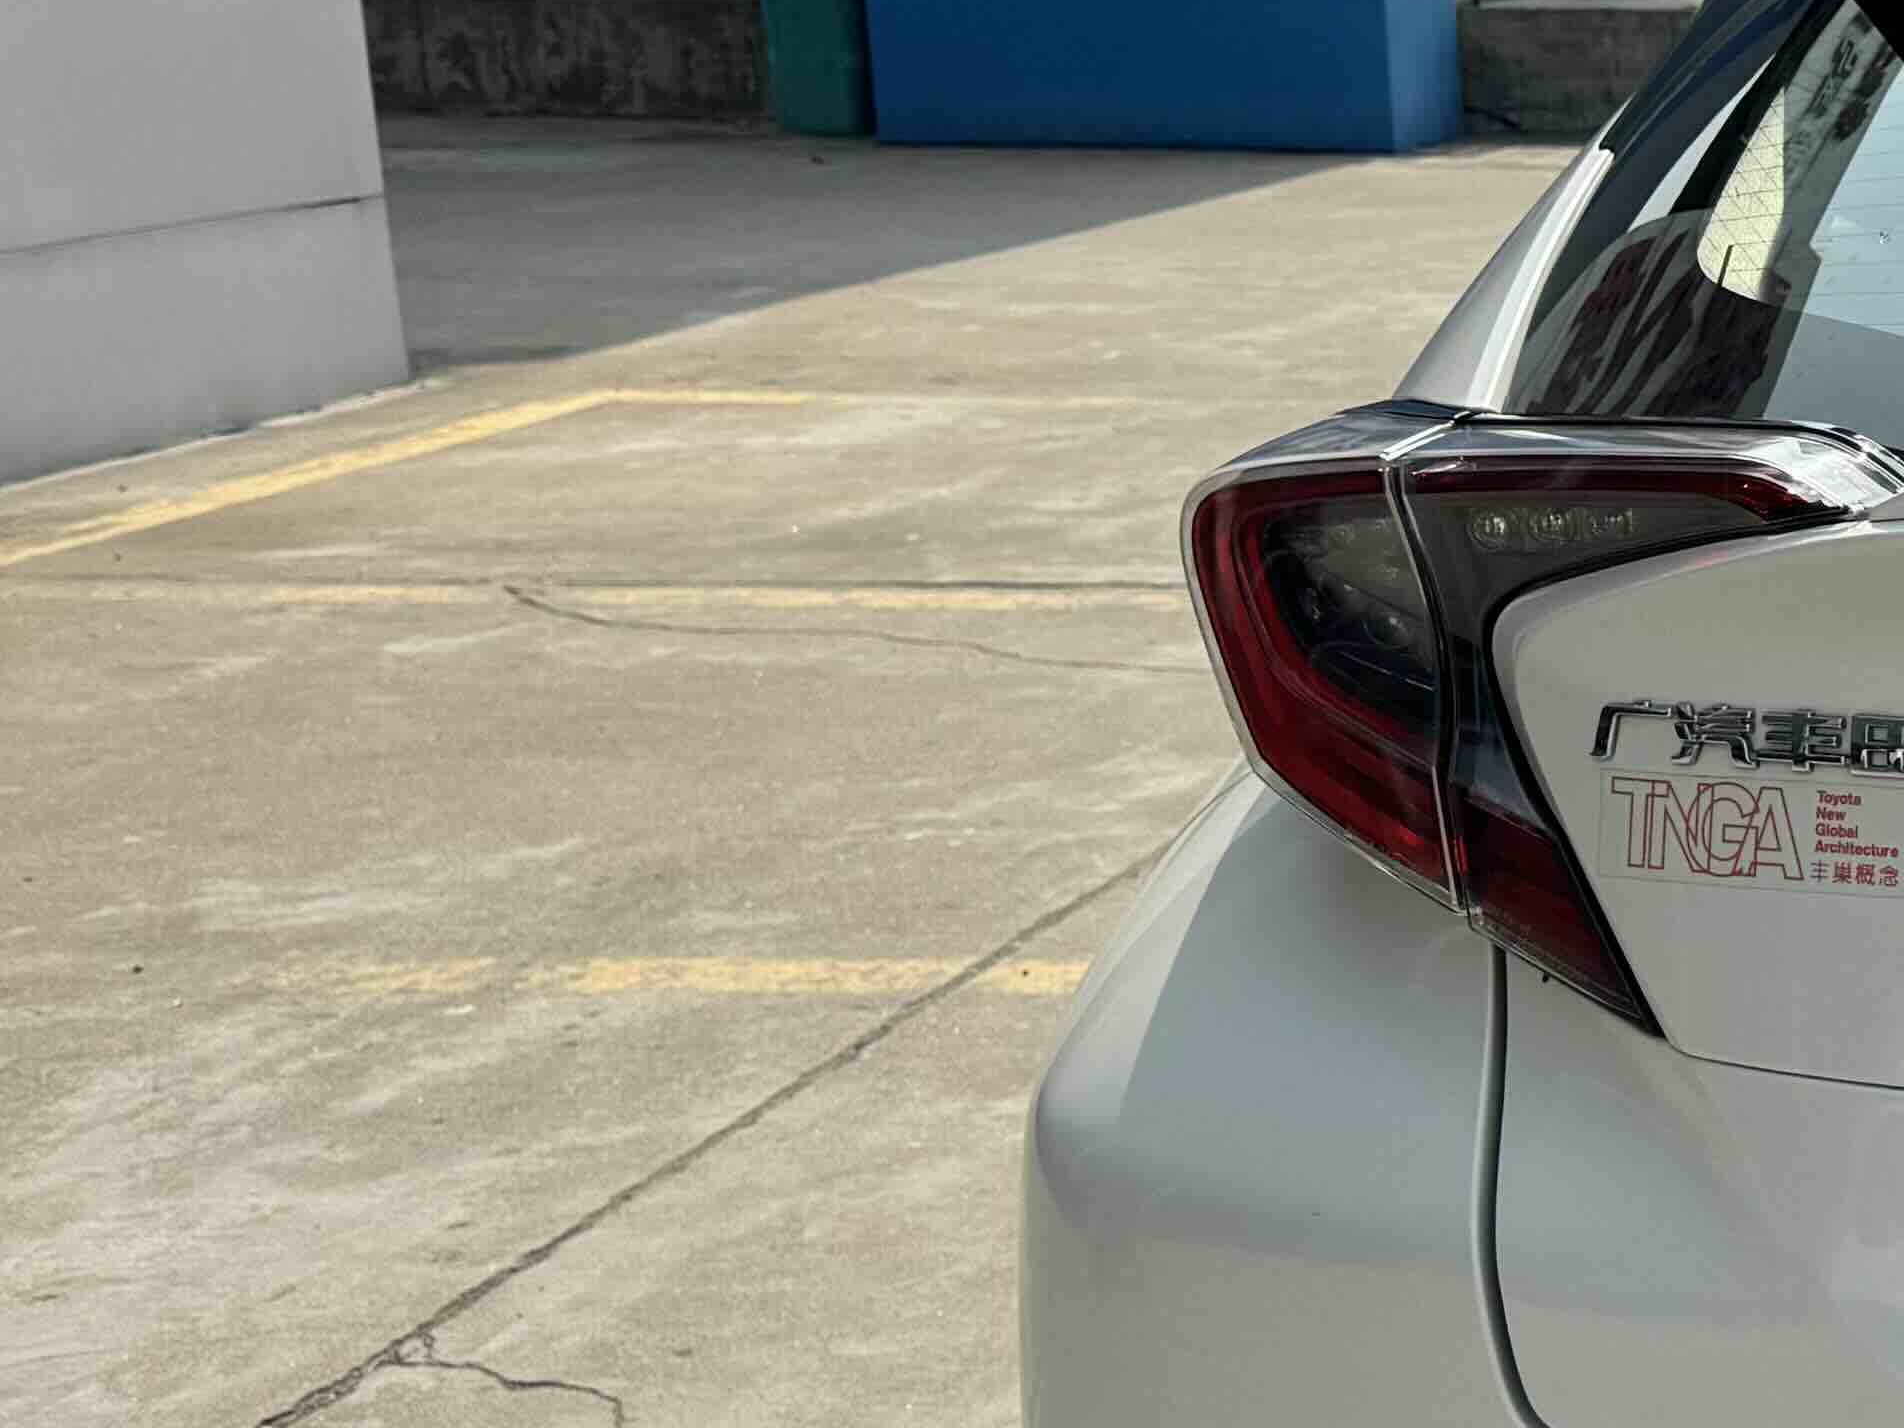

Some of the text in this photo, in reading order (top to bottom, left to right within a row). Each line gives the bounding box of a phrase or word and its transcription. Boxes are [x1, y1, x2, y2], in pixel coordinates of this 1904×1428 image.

[1816, 790, 1862, 807] Toyota
[1815, 806, 1847, 821] New
[1610, 775, 1805, 882] TNGA
[1815, 822, 1859, 839] Global
[1814, 839, 1900, 858] Architecture
[1809, 859, 1900, 887] 丰巢概念
